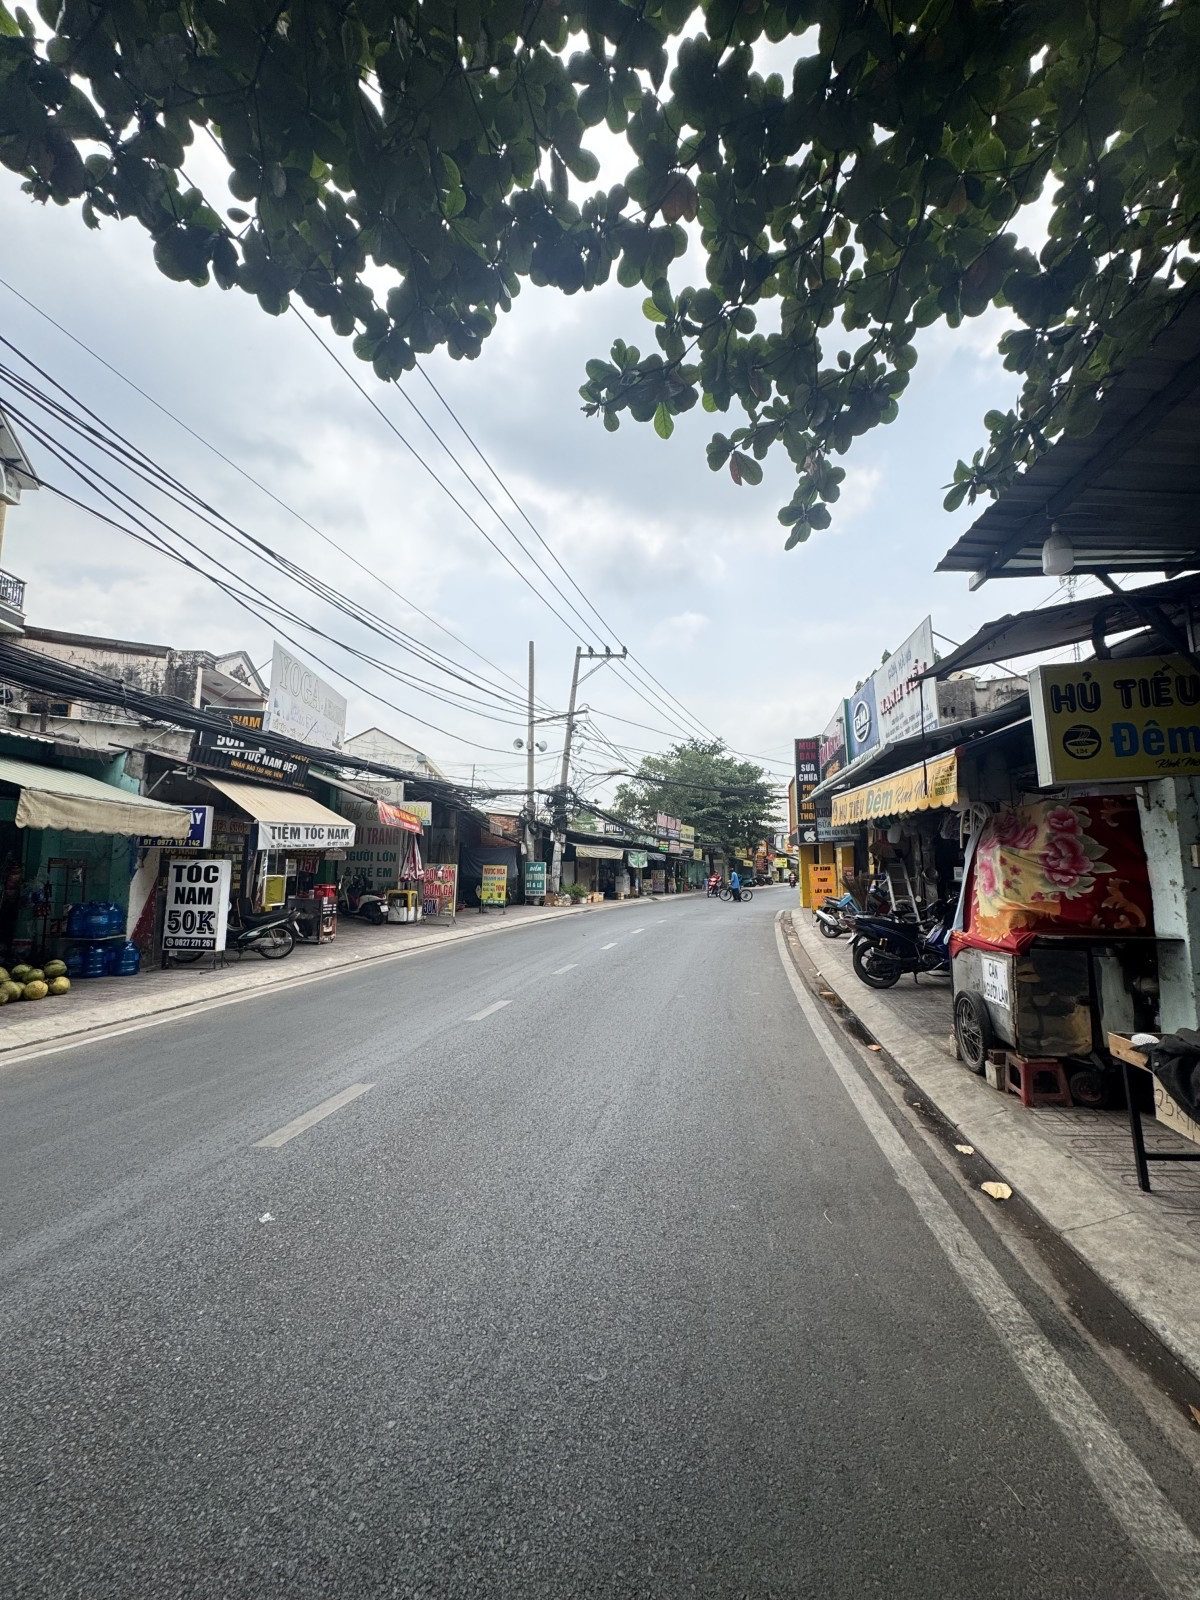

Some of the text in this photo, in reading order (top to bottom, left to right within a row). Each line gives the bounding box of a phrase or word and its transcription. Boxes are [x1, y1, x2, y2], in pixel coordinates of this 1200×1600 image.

[1050, 665, 1200, 714] HỦ TIẾU
[1109, 719, 1200, 758] Đêm
[262, 755, 283, 769] NAM
[269, 823, 350, 843] TIỆM TÓC NAM
[172, 862, 220, 884] TÓC
[376, 866, 393, 877] EM
[173, 886, 214, 906] NAM
[166, 909, 217, 935] 50K
